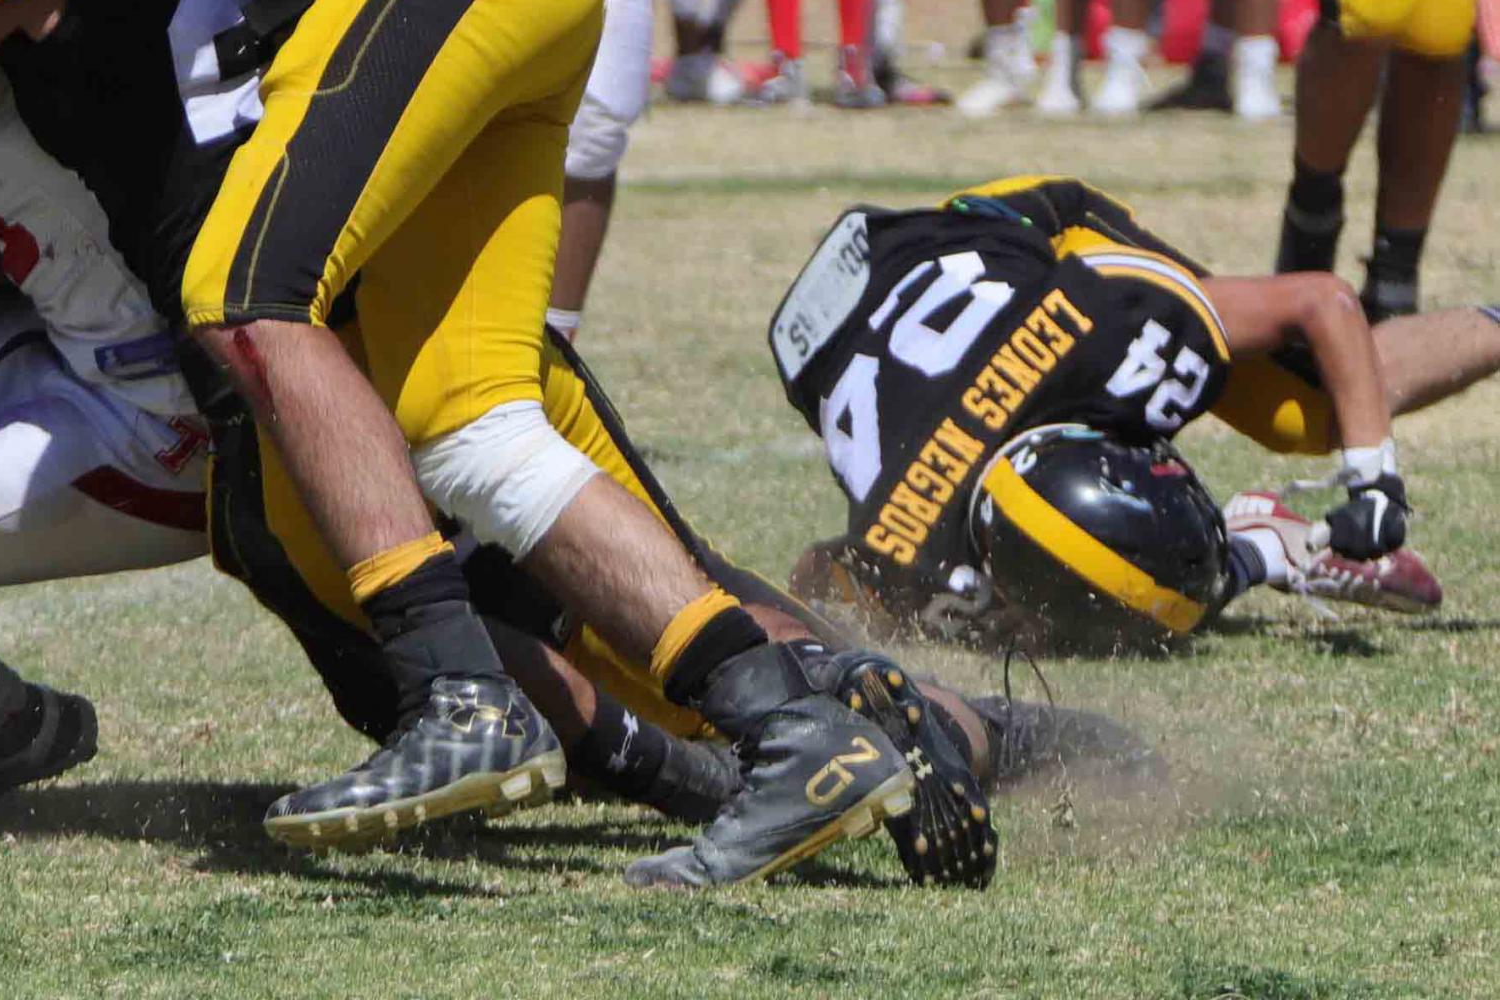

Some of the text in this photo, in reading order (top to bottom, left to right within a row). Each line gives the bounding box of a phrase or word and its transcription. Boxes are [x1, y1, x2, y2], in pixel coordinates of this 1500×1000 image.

[865, 287, 1094, 566] LEONES NEGROS
[1105, 318, 1210, 431] 24
